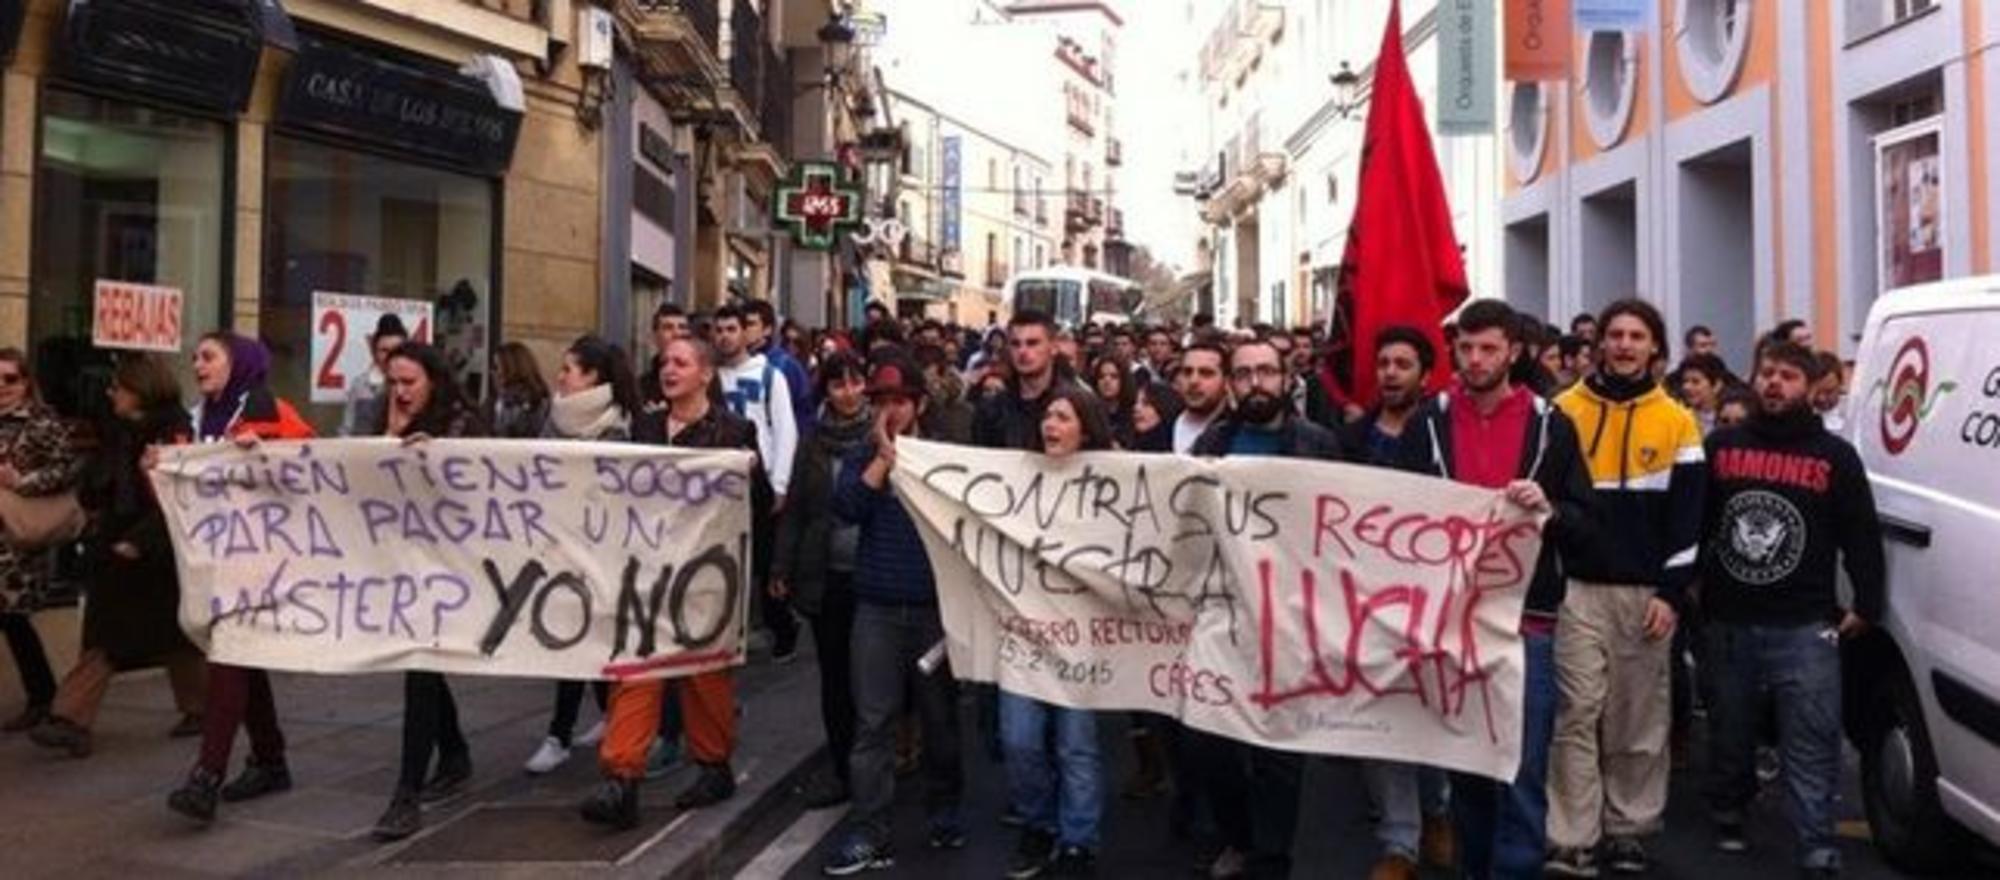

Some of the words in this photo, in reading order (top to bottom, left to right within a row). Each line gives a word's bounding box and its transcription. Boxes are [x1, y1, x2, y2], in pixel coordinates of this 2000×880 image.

[99, 286, 179, 344] REBAJAS
[317, 310, 347, 389] 2
[1714, 448, 1832, 492] RAMONES
[188, 500, 345, 558] PARA
[360, 498, 560, 547] PAGAR
[583, 504, 665, 549] UN
[1168, 474, 1290, 543] SUS
[480, 557, 593, 657] YO
